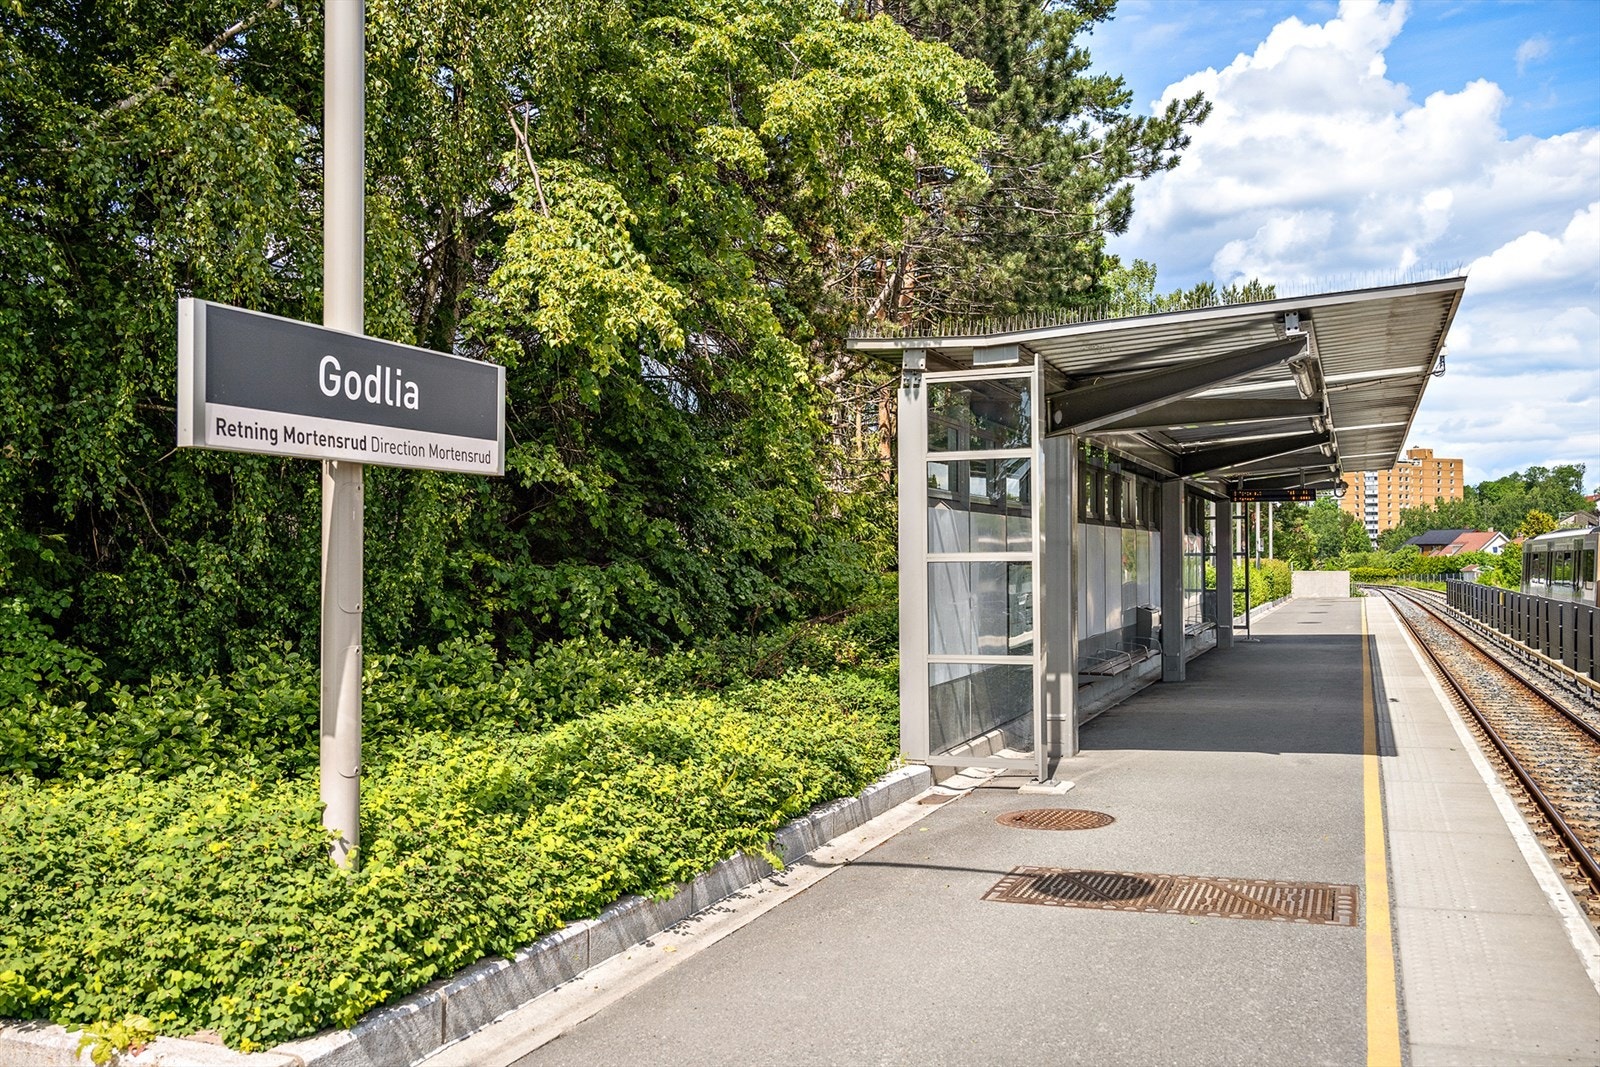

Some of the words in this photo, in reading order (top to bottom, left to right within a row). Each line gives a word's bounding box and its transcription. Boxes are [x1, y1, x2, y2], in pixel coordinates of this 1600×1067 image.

[318, 355, 419, 410] Godlia
[216, 417, 278, 445] Retning
[283, 425, 367, 451] Mortensrud
[371, 436, 425, 458] Direction
[429, 443, 491, 465] Mortensrud
